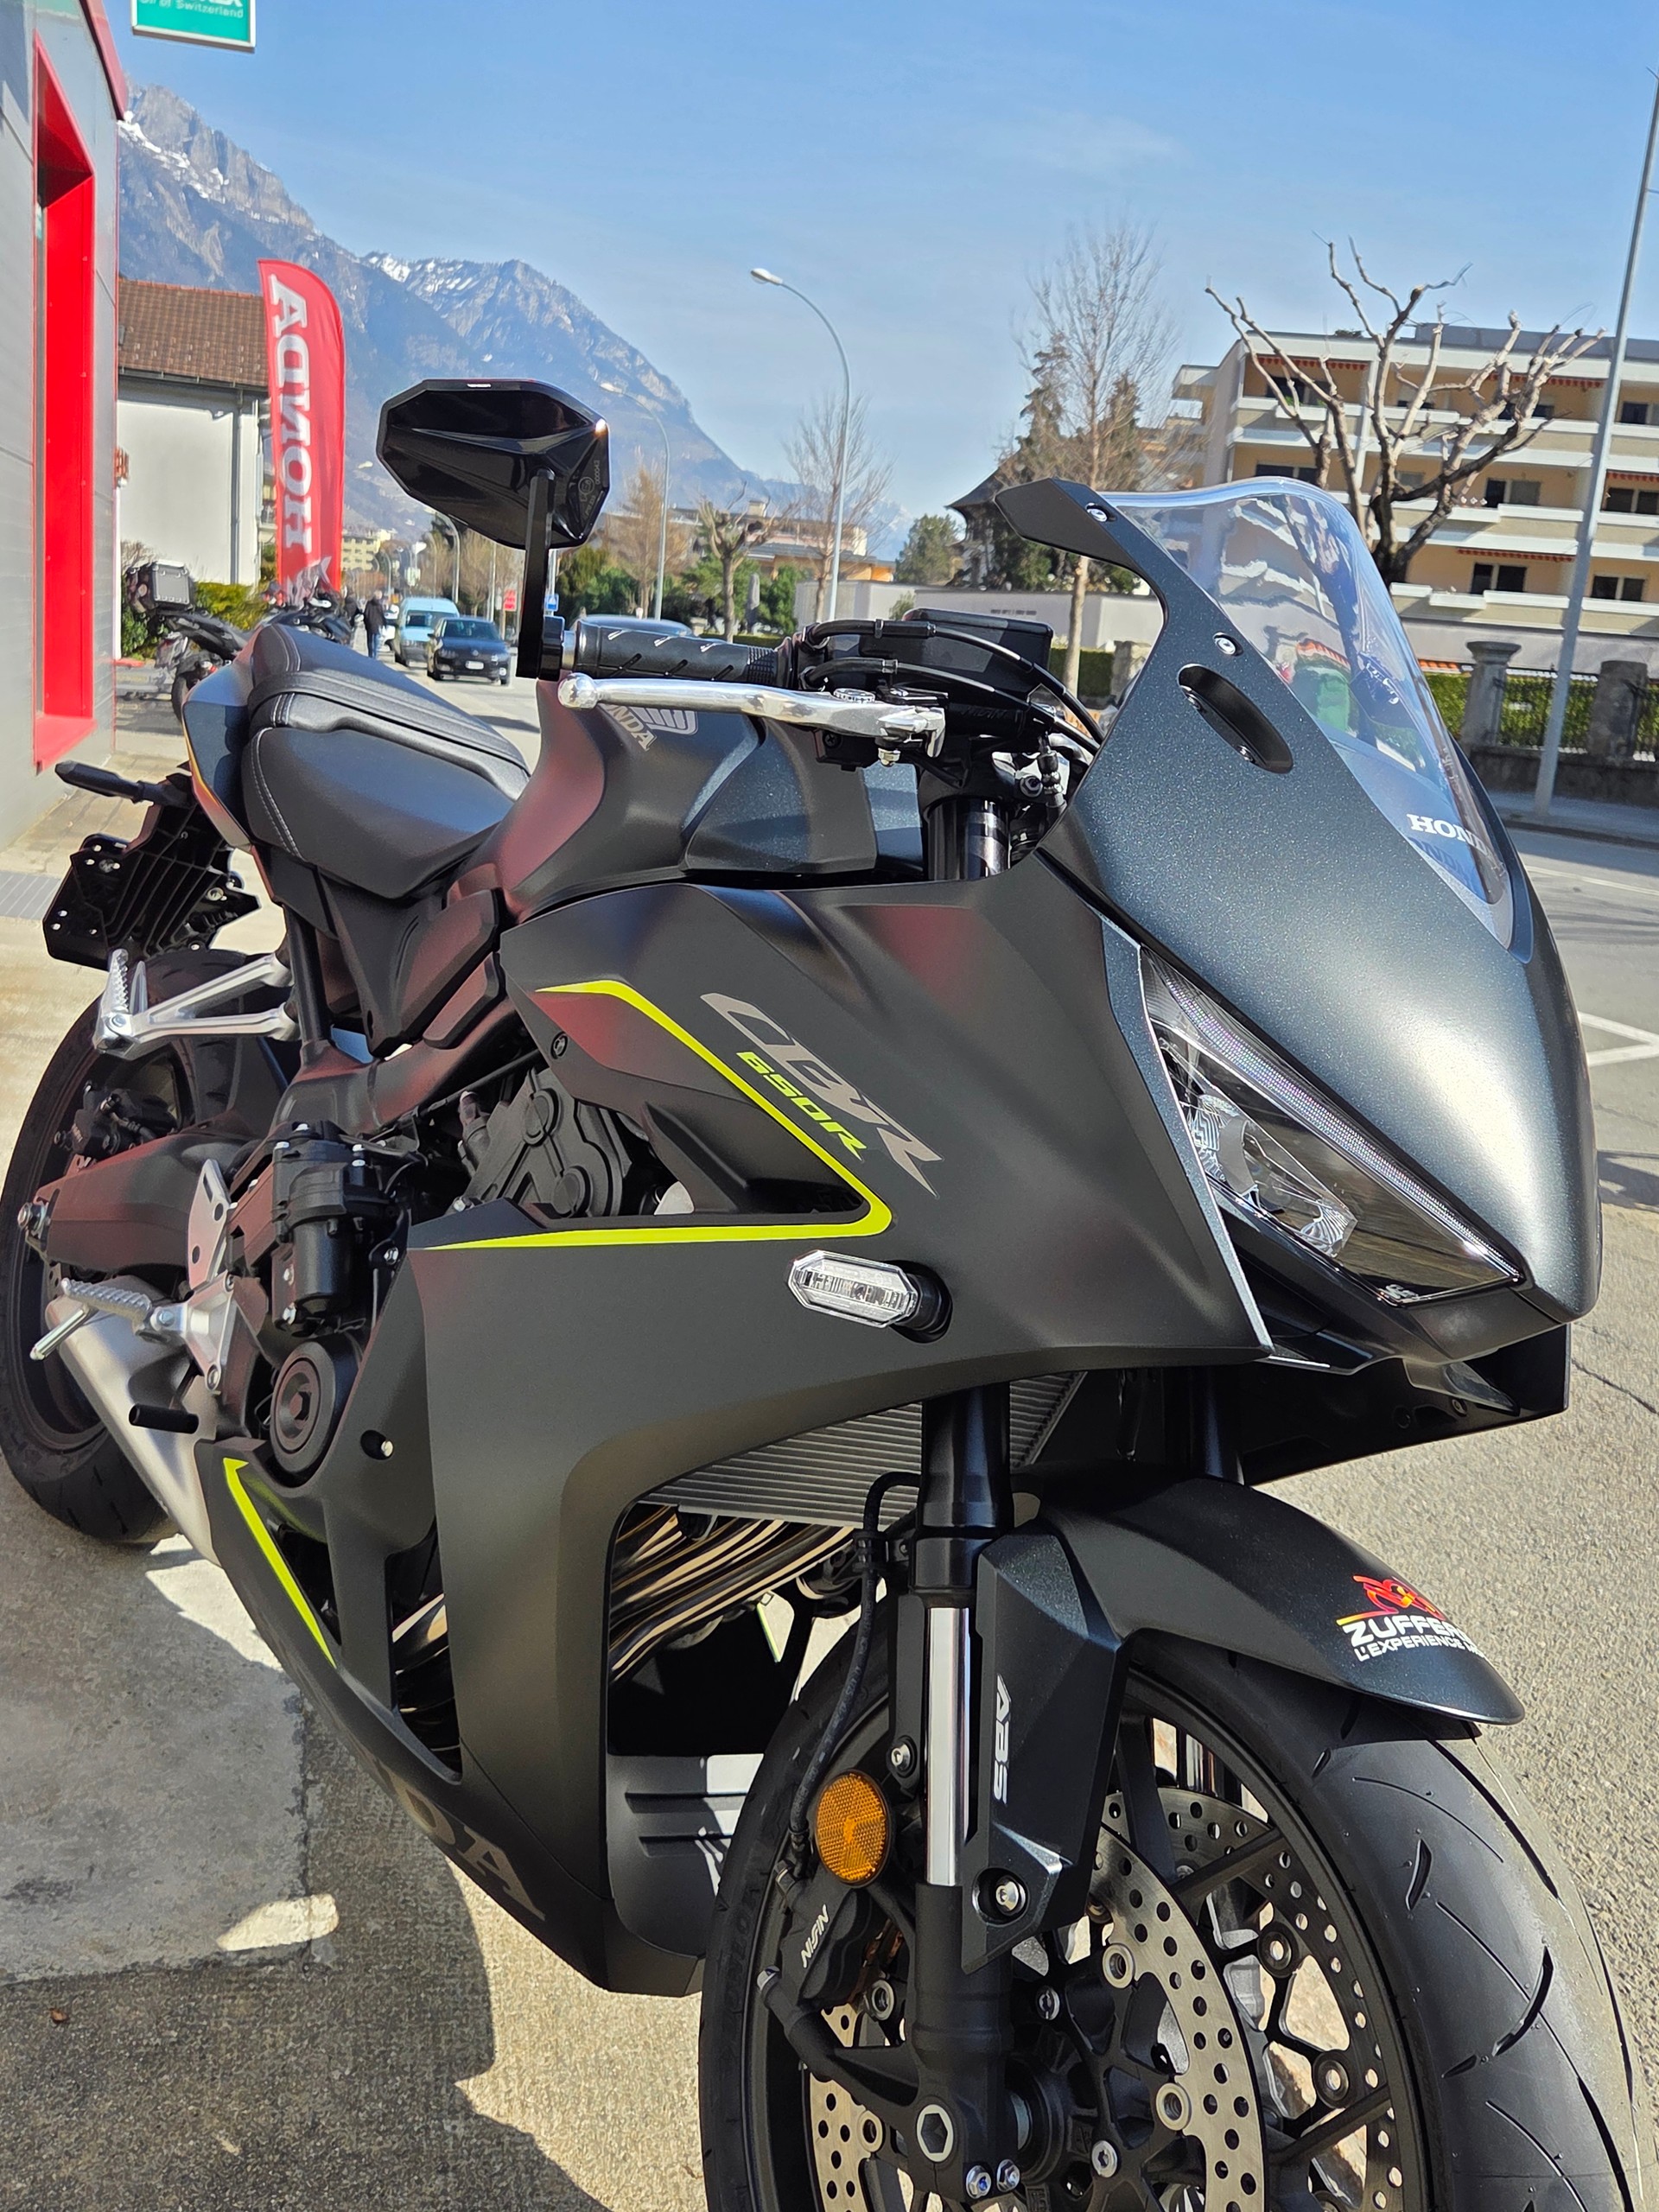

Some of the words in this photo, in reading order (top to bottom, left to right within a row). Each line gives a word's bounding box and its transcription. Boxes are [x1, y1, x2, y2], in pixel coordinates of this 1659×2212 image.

[175, 0, 244, 18] Switzerland
[700, 993, 943, 1198] CBR
[736, 1051, 868, 1161] 650R
[994, 1675, 1011, 1804] ABS
